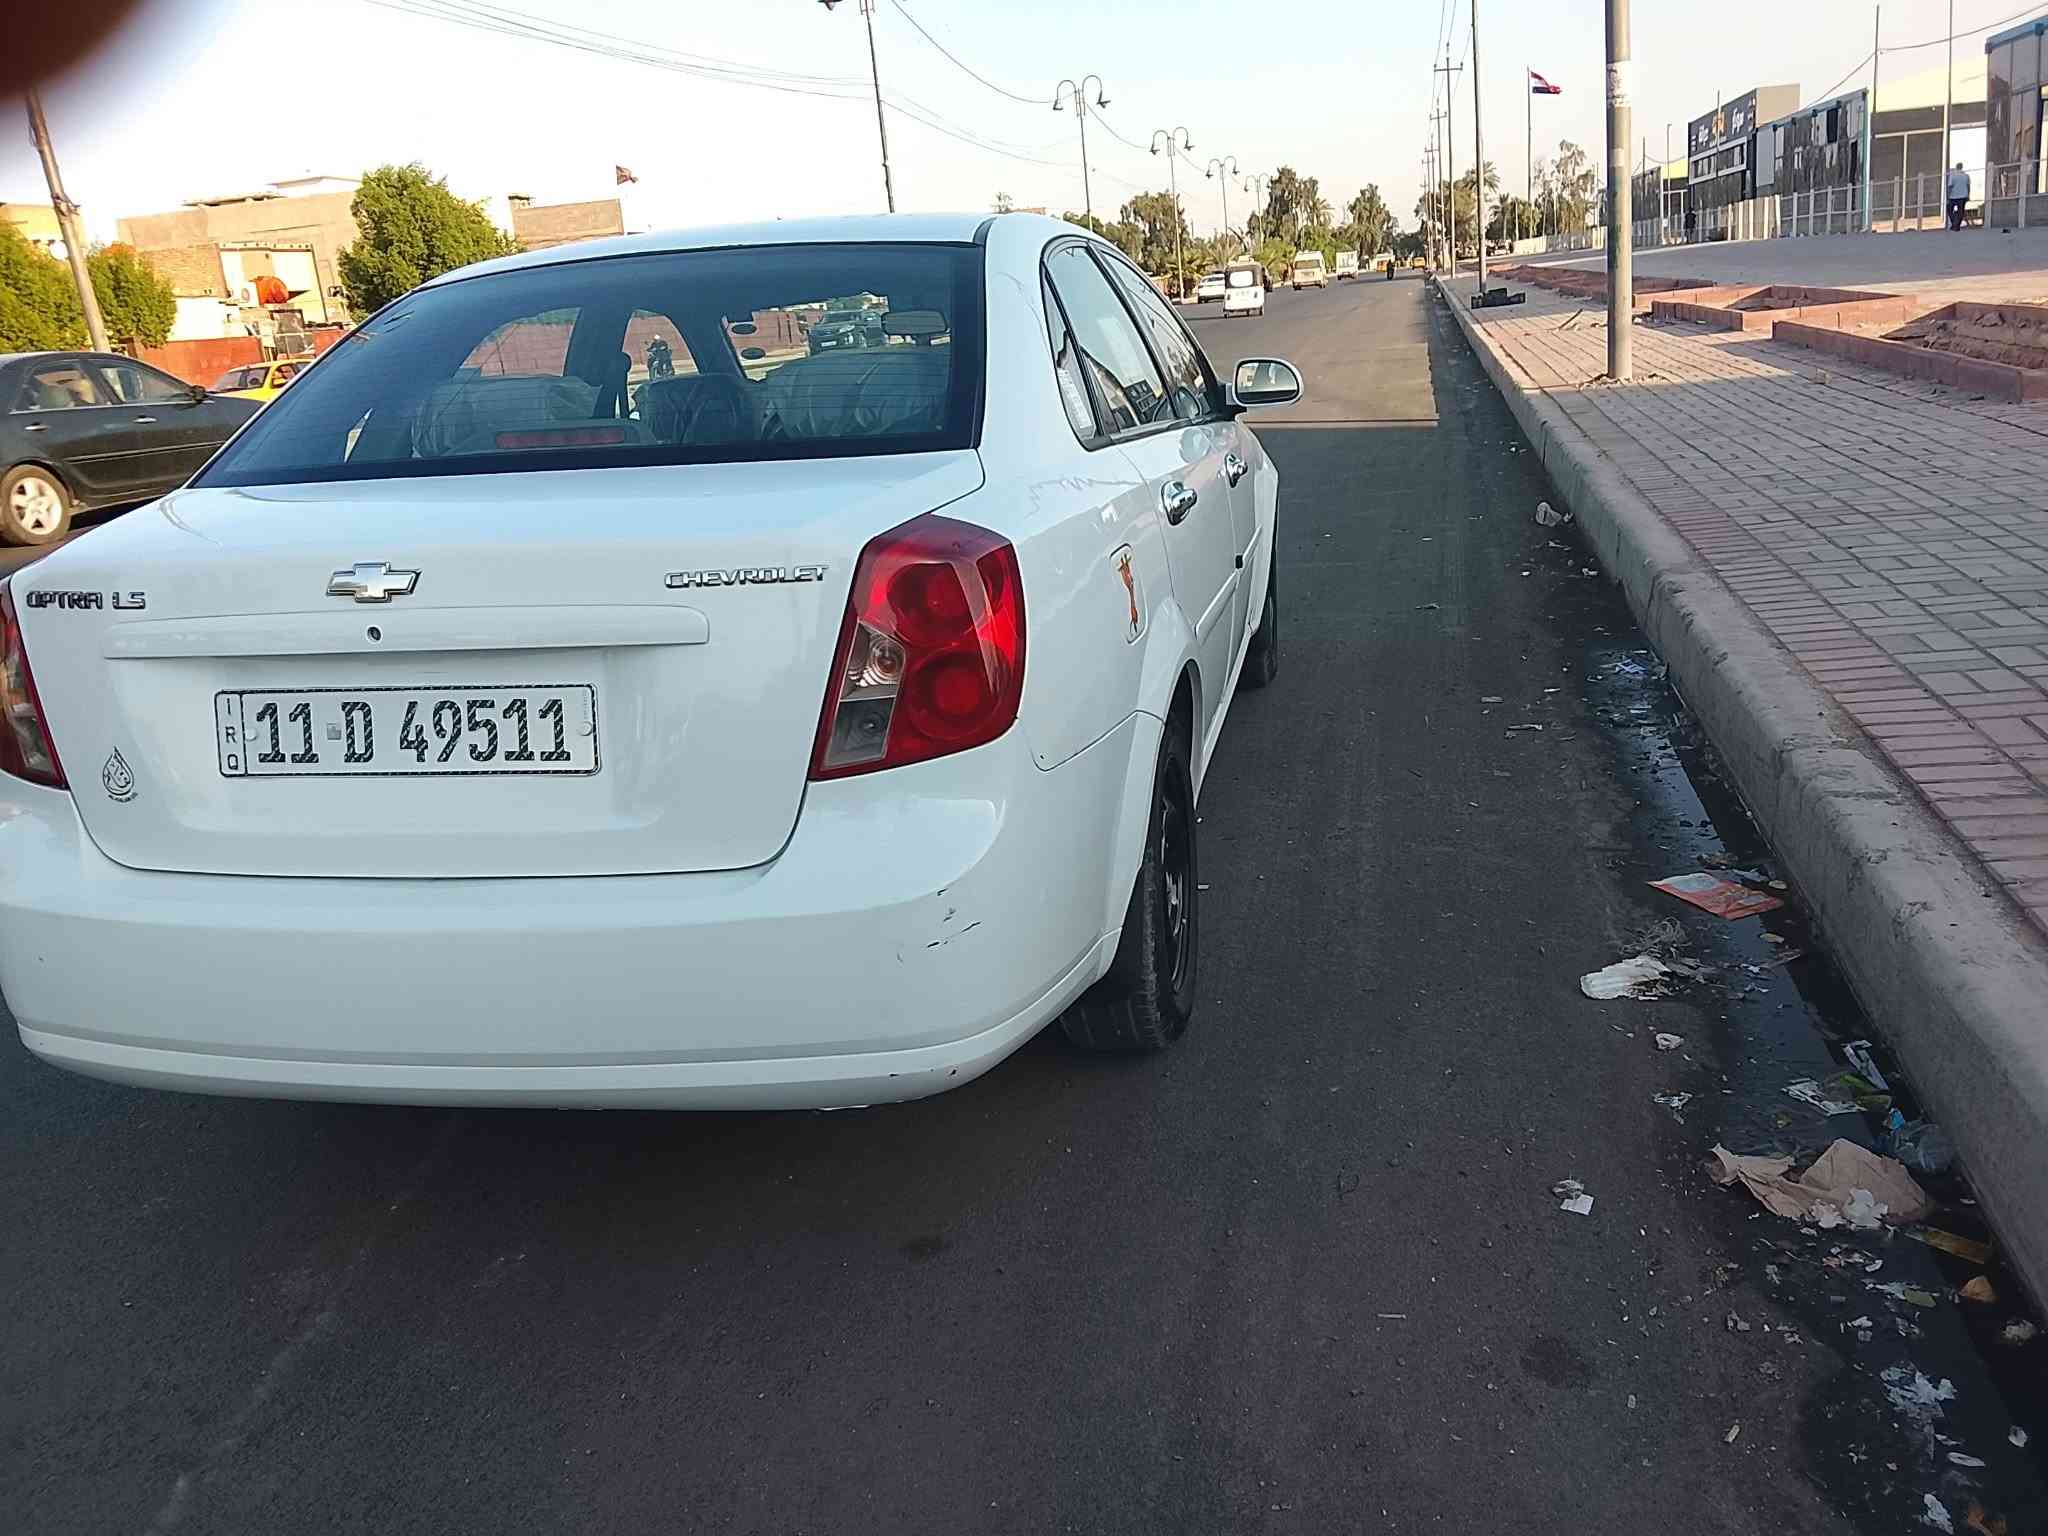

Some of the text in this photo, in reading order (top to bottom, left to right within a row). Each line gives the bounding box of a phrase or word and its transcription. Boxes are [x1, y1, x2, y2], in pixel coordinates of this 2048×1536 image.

[665, 565, 828, 588] CHEVROLET
[26, 591, 145, 610] OPTRA LS
[256, 698, 571, 763] 11 D 49511
